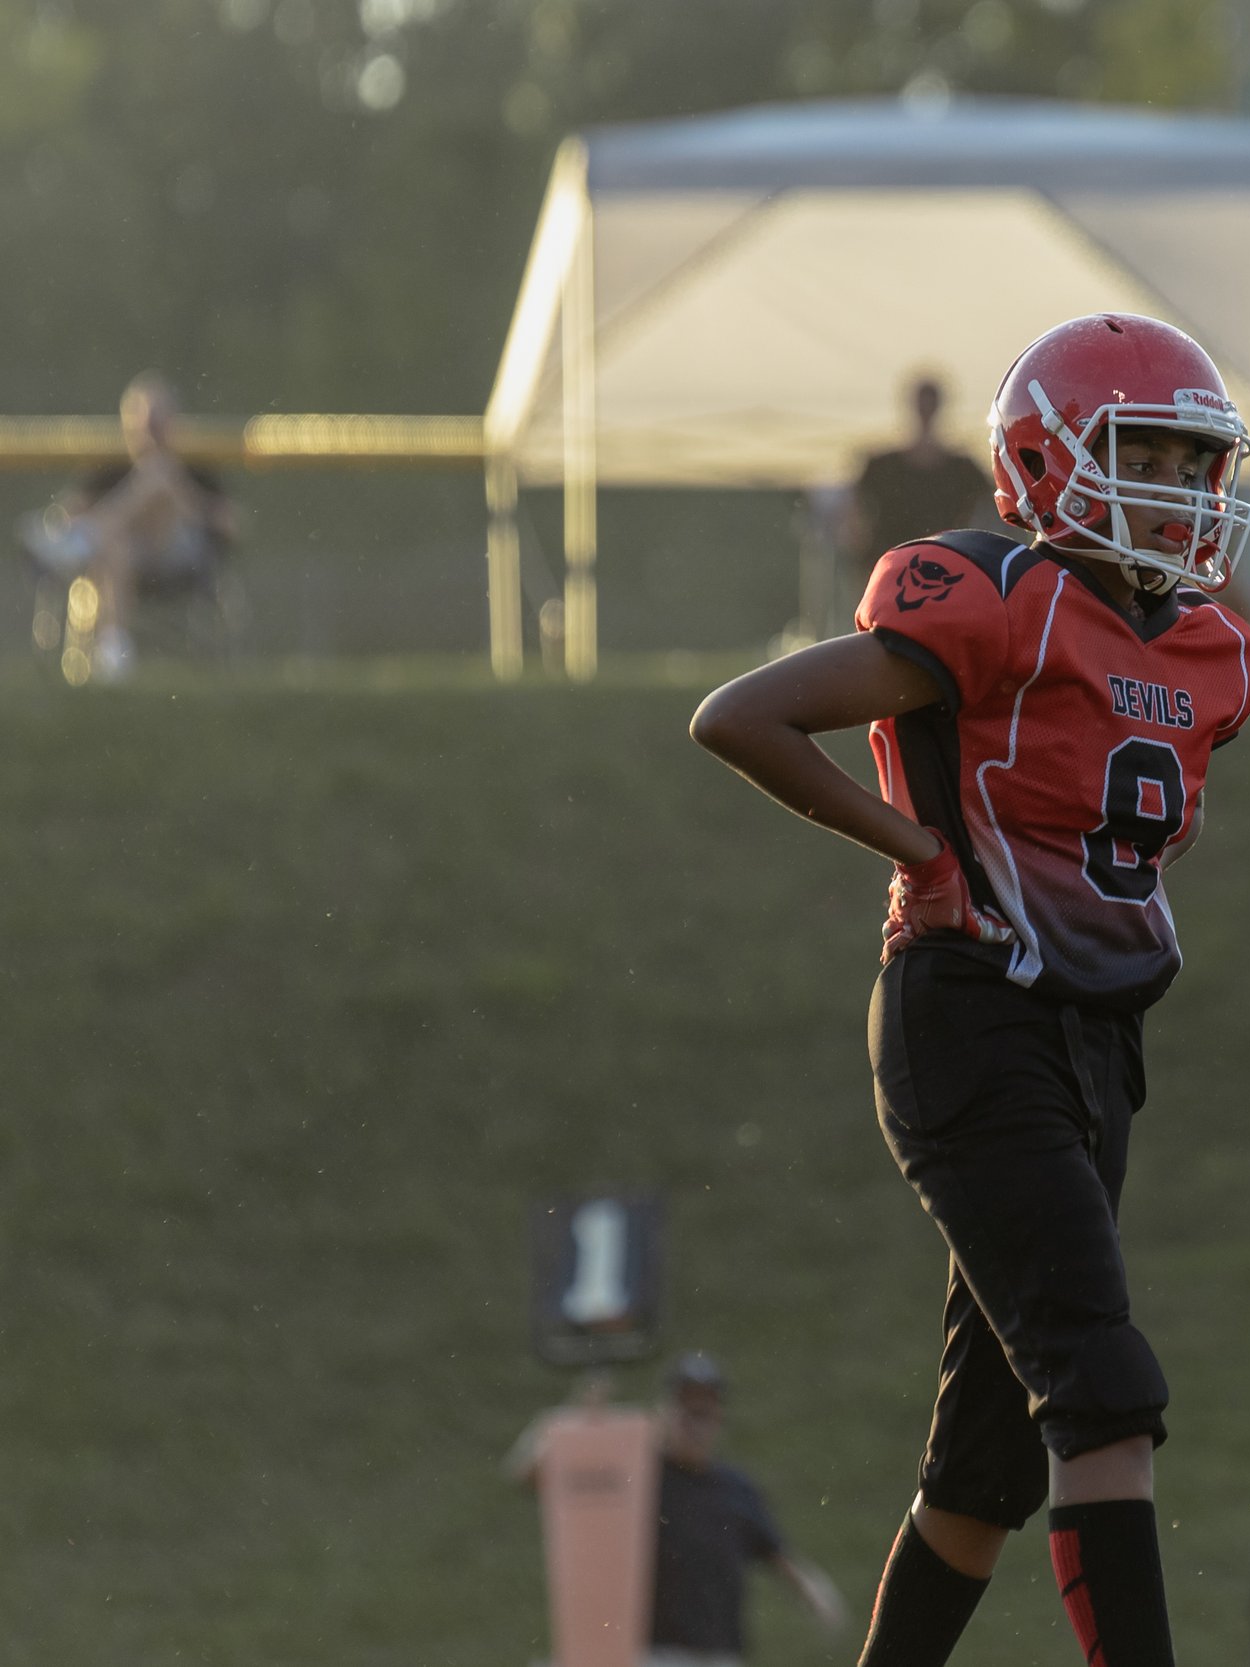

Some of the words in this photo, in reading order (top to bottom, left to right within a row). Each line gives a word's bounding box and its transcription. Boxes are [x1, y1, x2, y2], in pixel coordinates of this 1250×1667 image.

[1107, 674, 1194, 730] DEVILS
[1081, 735, 1187, 907] 8
[562, 1200, 630, 1322] 1
